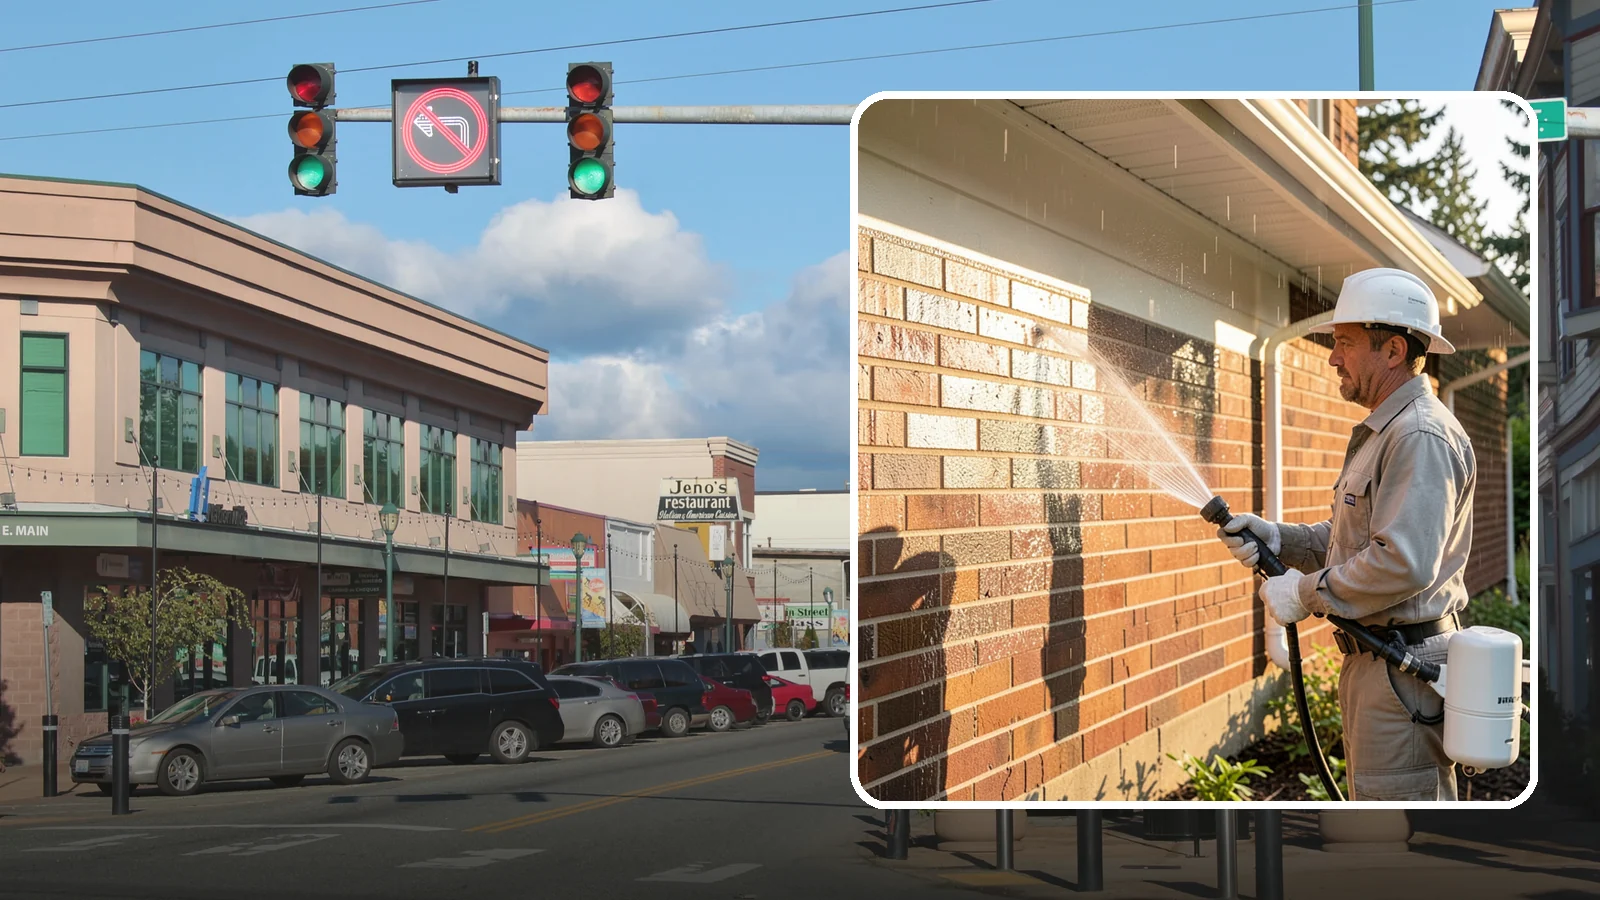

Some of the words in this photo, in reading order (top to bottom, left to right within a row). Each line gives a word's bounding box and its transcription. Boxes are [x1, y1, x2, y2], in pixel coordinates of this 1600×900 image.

[670, 480, 727, 494] Jeno's
[665, 496, 731, 509] restaurant
[659, 509, 681, 519] Italian
[686, 509, 714, 519] American
[715, 509, 738, 519] Cuisine
[2, 525, 13, 536] E.
[15, 525, 49, 536] MAIN
[797, 607, 828, 616] Street
